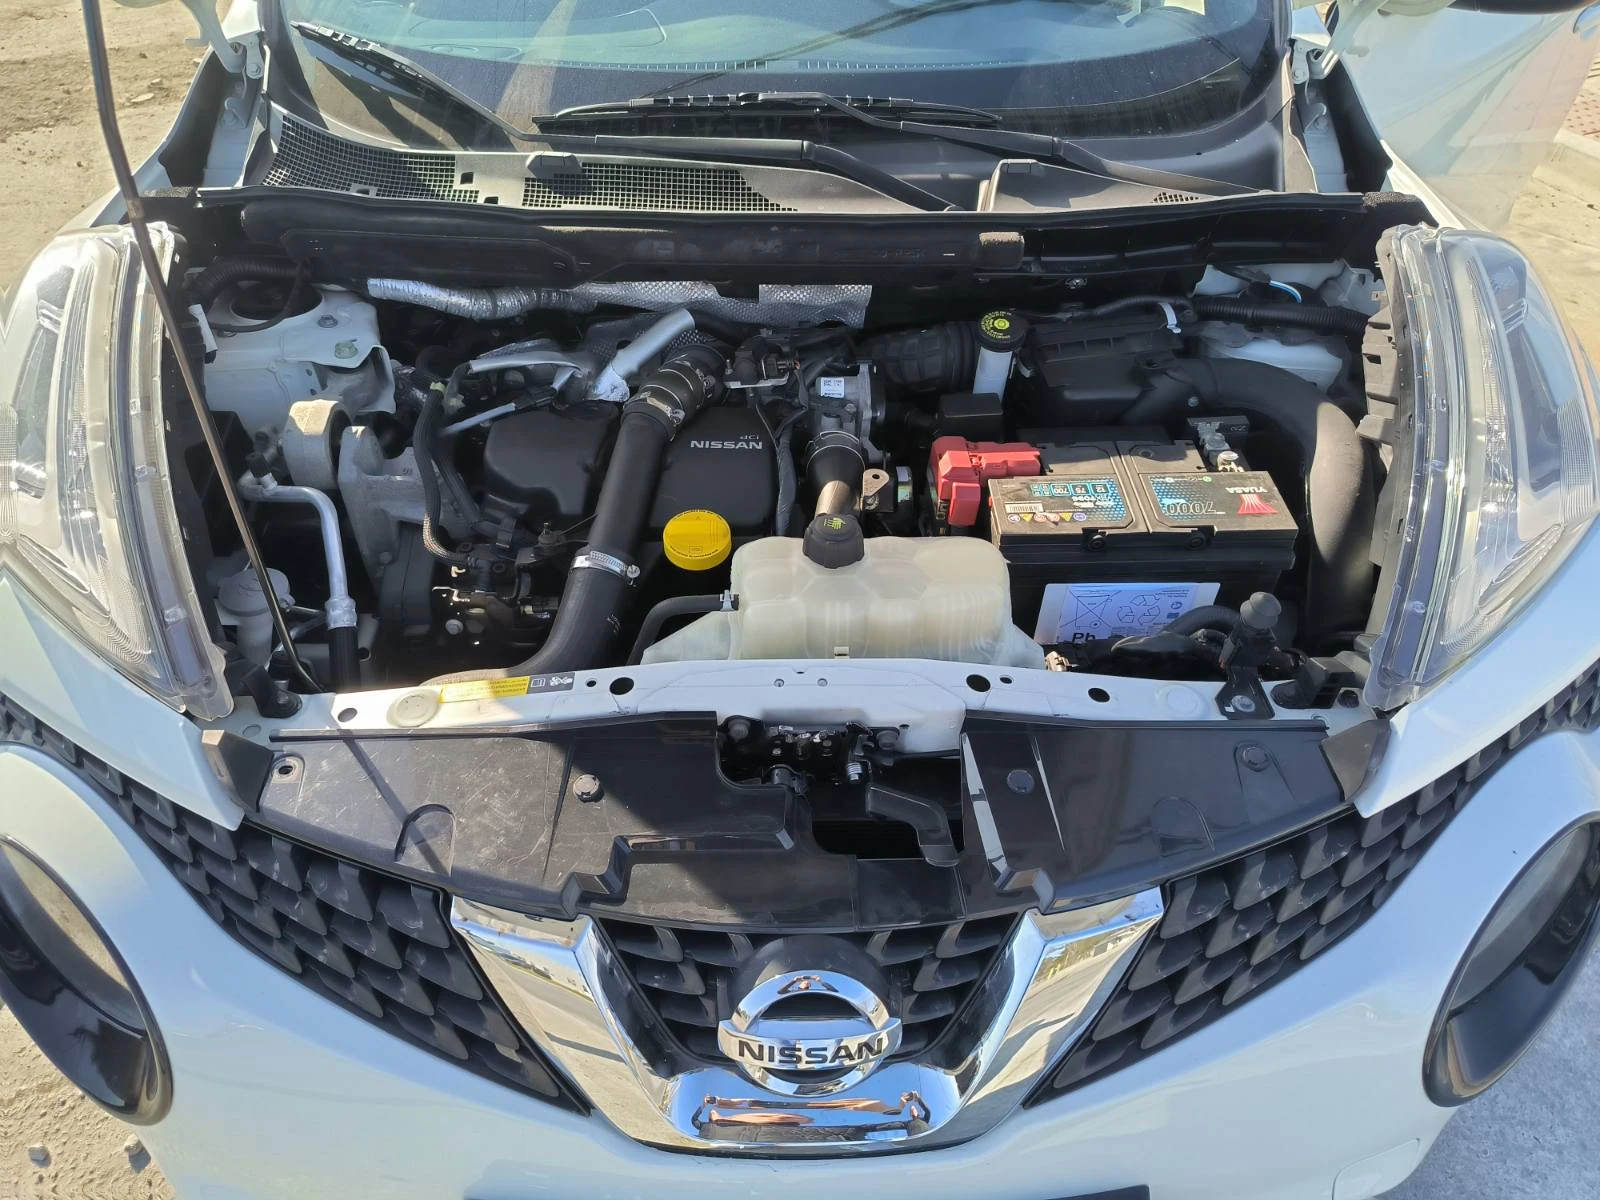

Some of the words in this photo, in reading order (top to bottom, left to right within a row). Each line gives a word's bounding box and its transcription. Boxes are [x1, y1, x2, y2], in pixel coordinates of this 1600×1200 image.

[690, 440, 763, 450] NISSAN
[1225, 486, 1269, 494] YUASA
[1166, 501, 1217, 515] 7000
[738, 1038, 884, 1065] NISSAN
